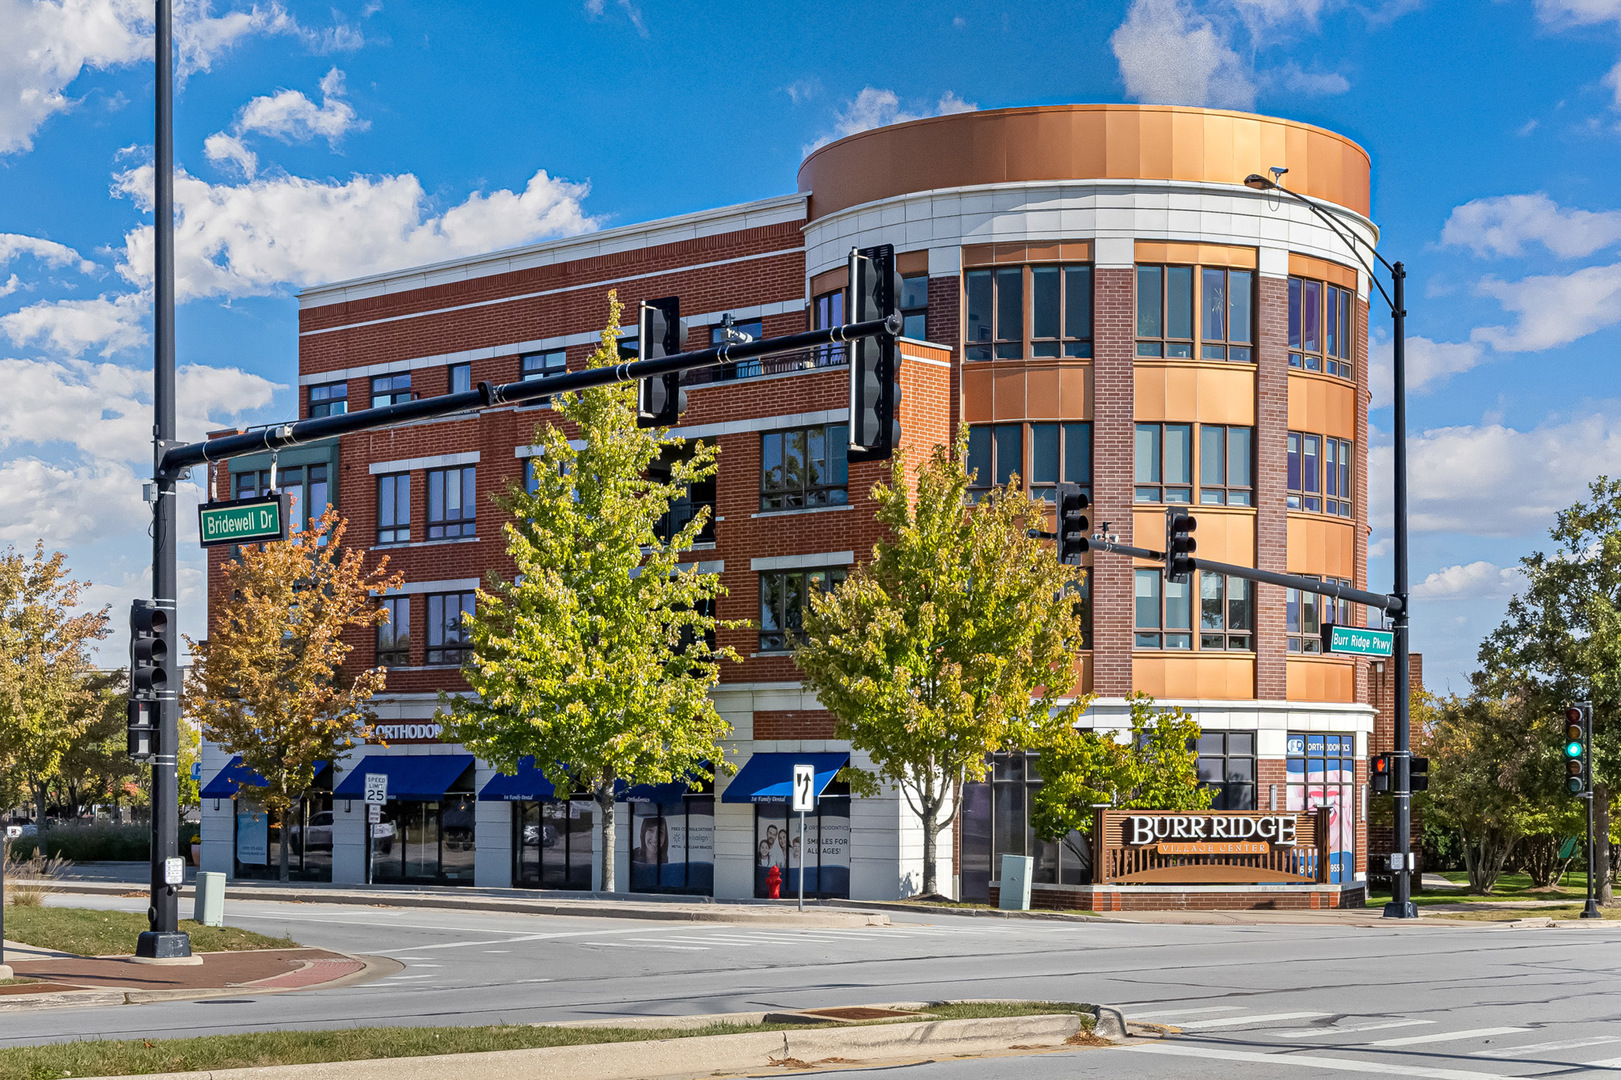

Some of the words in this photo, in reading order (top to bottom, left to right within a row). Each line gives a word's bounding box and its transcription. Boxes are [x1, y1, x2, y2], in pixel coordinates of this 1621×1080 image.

[207, 511, 255, 535] Bridewell
[260, 510, 273, 529] Dr
[1333, 633, 1349, 646] Burr
[1351, 634, 1371, 651] Ridge
[1372, 636, 1391, 653] Pkwy
[375, 724, 457, 739] ORTHODON
[367, 789, 384, 802] 25
[757, 795, 772, 803] Family
[1129, 815, 1207, 845] BURR
[1211, 814, 1298, 846] RIDGE
[807, 837, 833, 845] SMILES
[1162, 844, 1214, 852] VILLAGE
[1219, 843, 1266, 852] CENTER
[807, 847, 818, 855] ALL
[822, 847, 842, 855] AGES!
